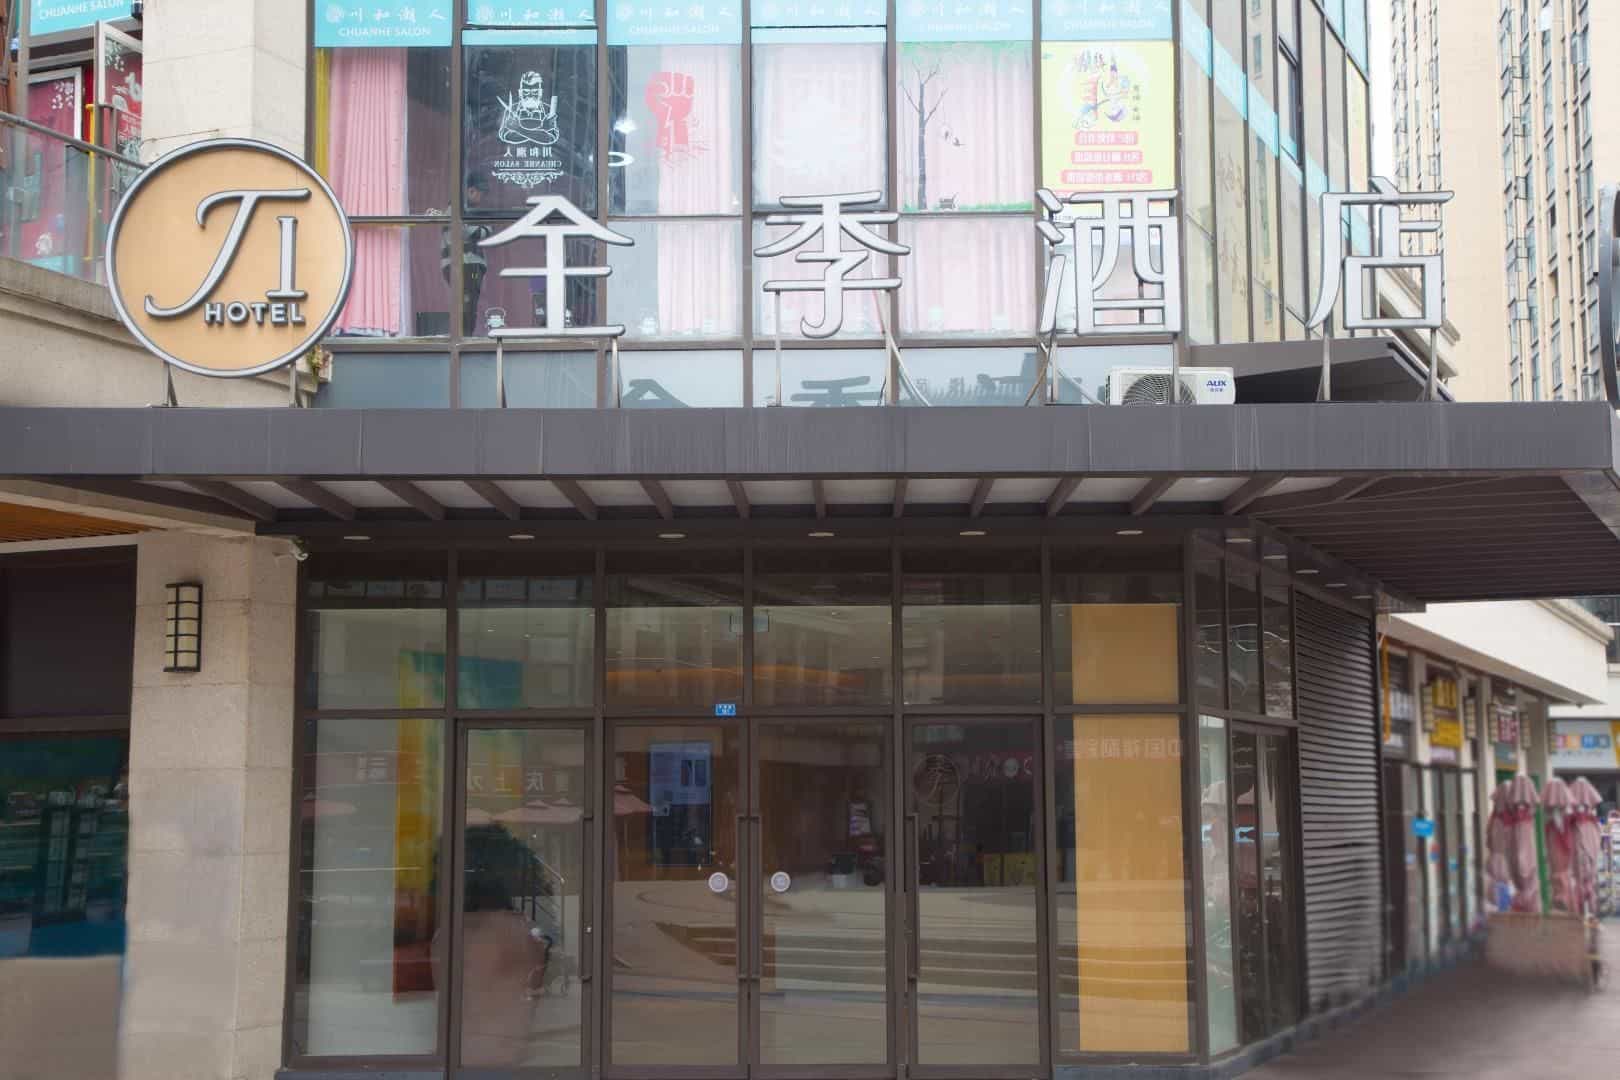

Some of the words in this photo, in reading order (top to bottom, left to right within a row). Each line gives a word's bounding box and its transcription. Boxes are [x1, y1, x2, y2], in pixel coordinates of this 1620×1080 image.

[477, 175, 1454, 339] 全季酒店
[203, 302, 306, 325] HOTEL
[1206, 379, 1227, 387] AUX
